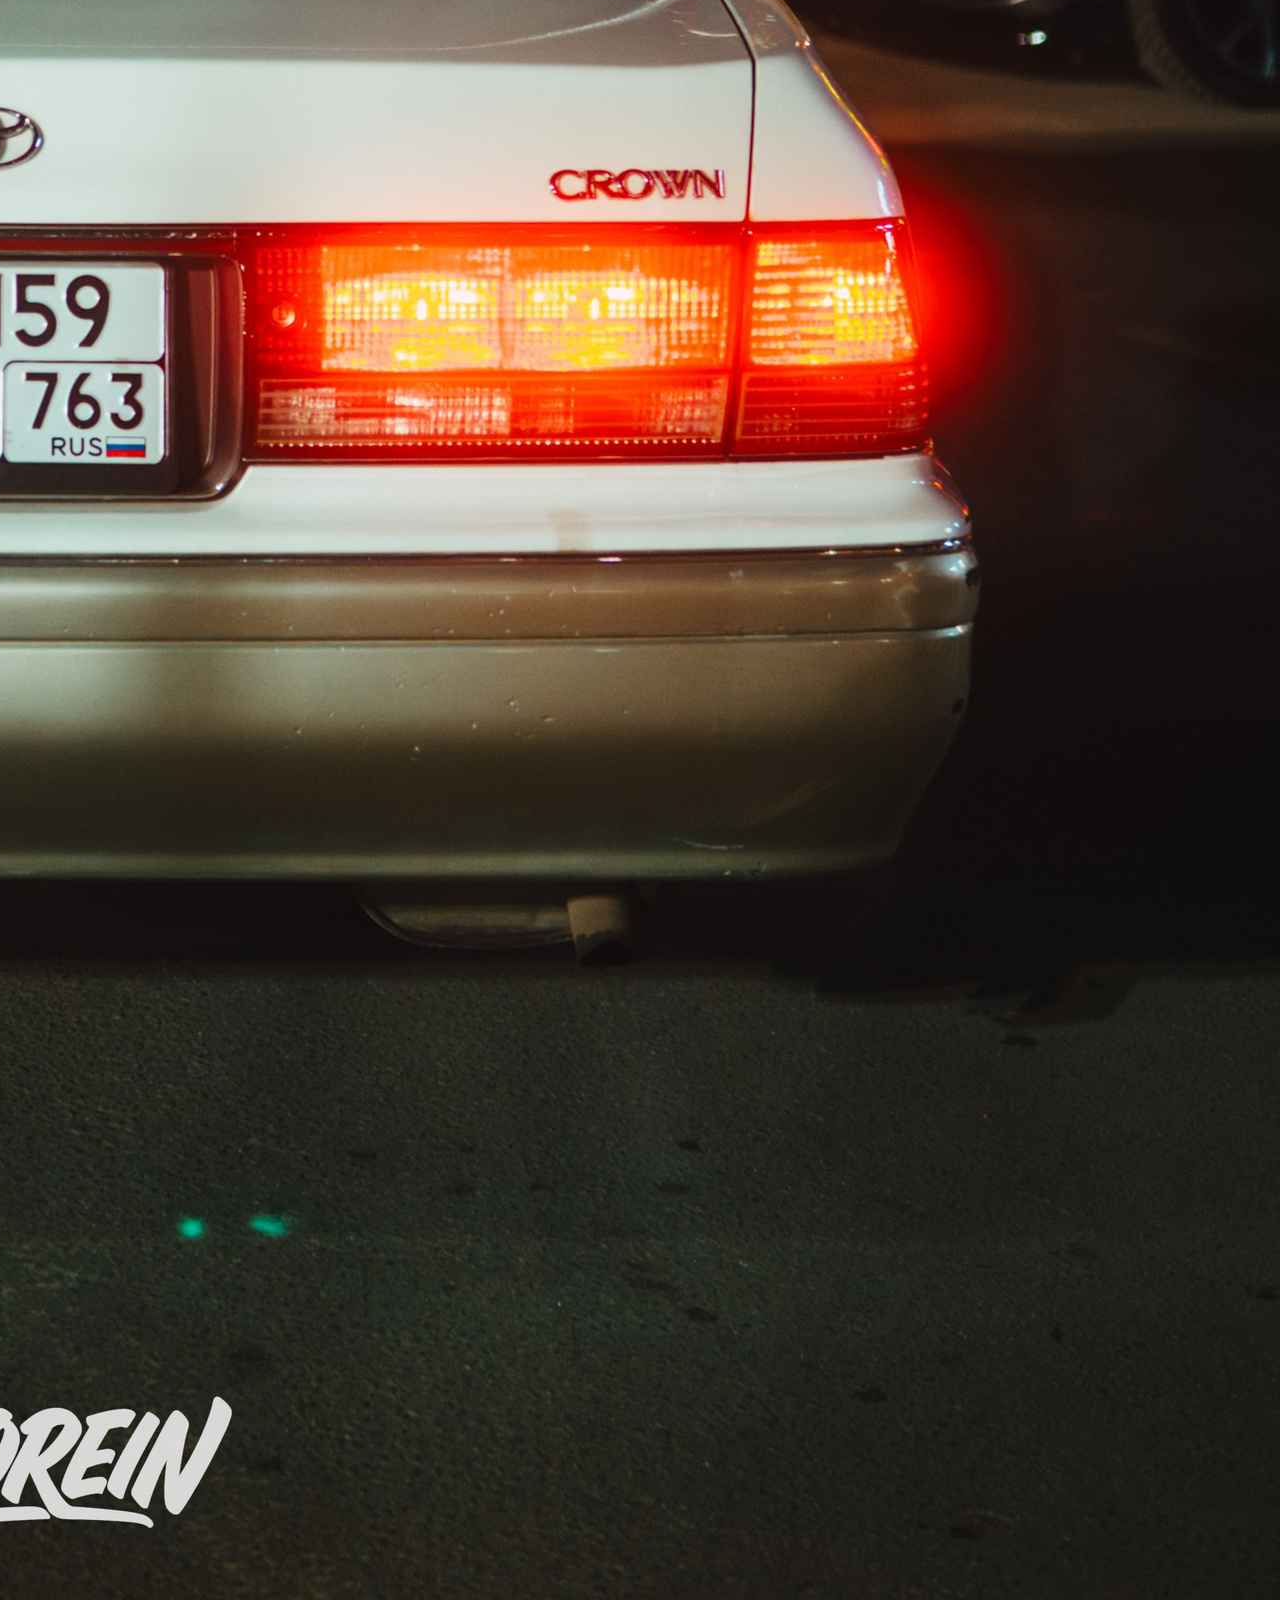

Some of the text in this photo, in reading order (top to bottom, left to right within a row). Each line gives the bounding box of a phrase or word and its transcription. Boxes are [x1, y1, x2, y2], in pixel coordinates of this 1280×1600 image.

[549, 169, 725, 201] CROWN
[24, 371, 144, 431] 763
[50, 436, 103, 457] RUS
